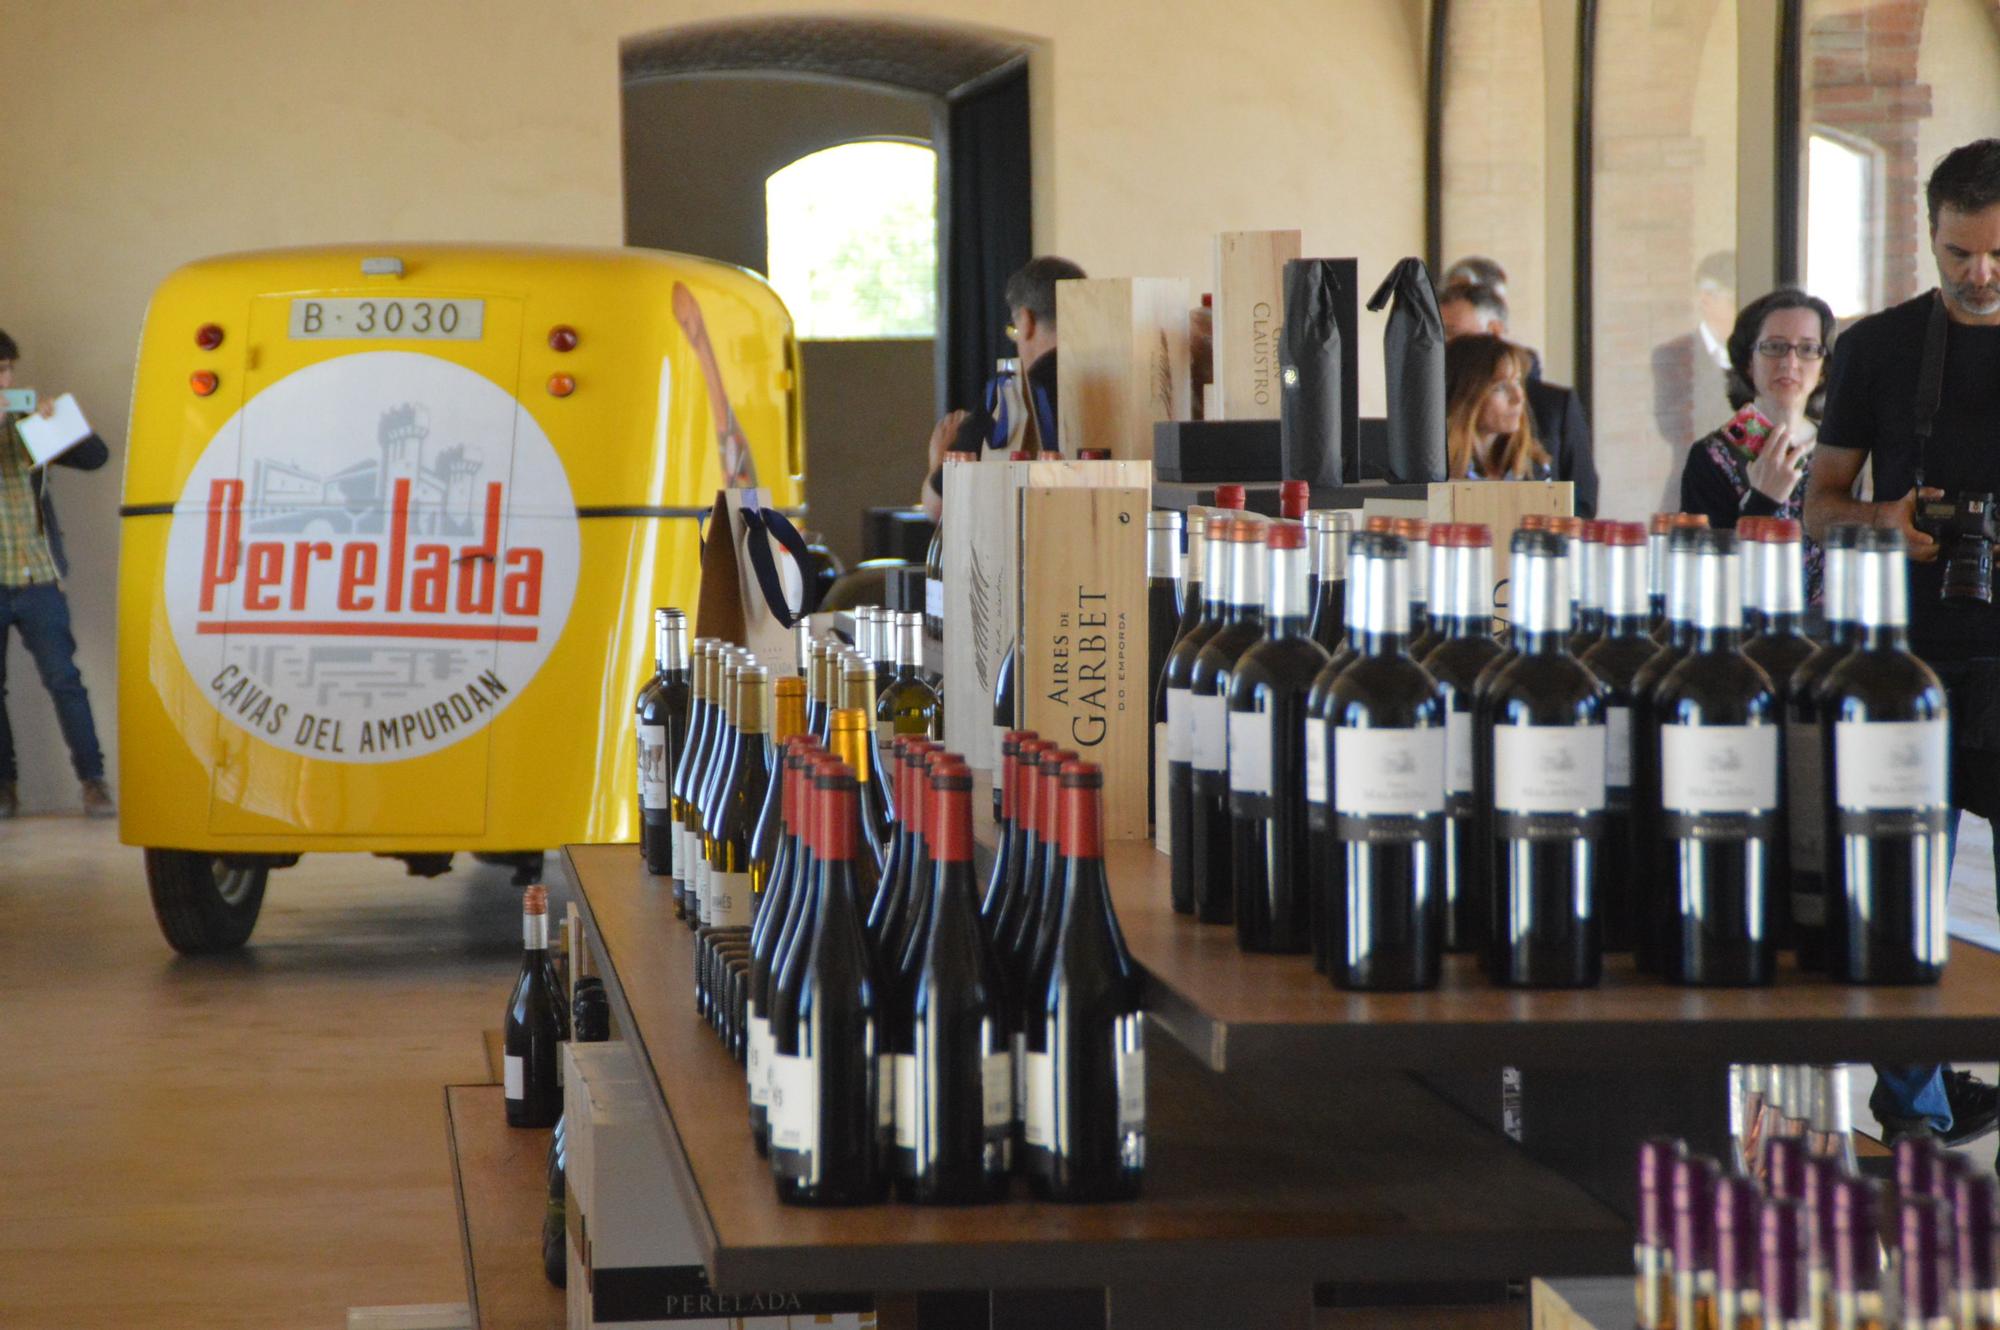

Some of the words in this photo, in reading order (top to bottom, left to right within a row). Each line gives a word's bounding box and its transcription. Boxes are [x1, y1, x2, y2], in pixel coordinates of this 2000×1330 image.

[1253, 302, 1271, 405] CLAUSTRO
[198, 477, 544, 616] Perelada
[1048, 635, 1069, 705] AIRES
[1060, 612, 1069, 627] DE
[1072, 585, 1107, 747] GARBET
[211, 664, 288, 735] CAVAS
[295, 713, 343, 753] DEL
[359, 668, 509, 753] AMPURDAN
[667, 1291, 801, 1315] PERELADA
